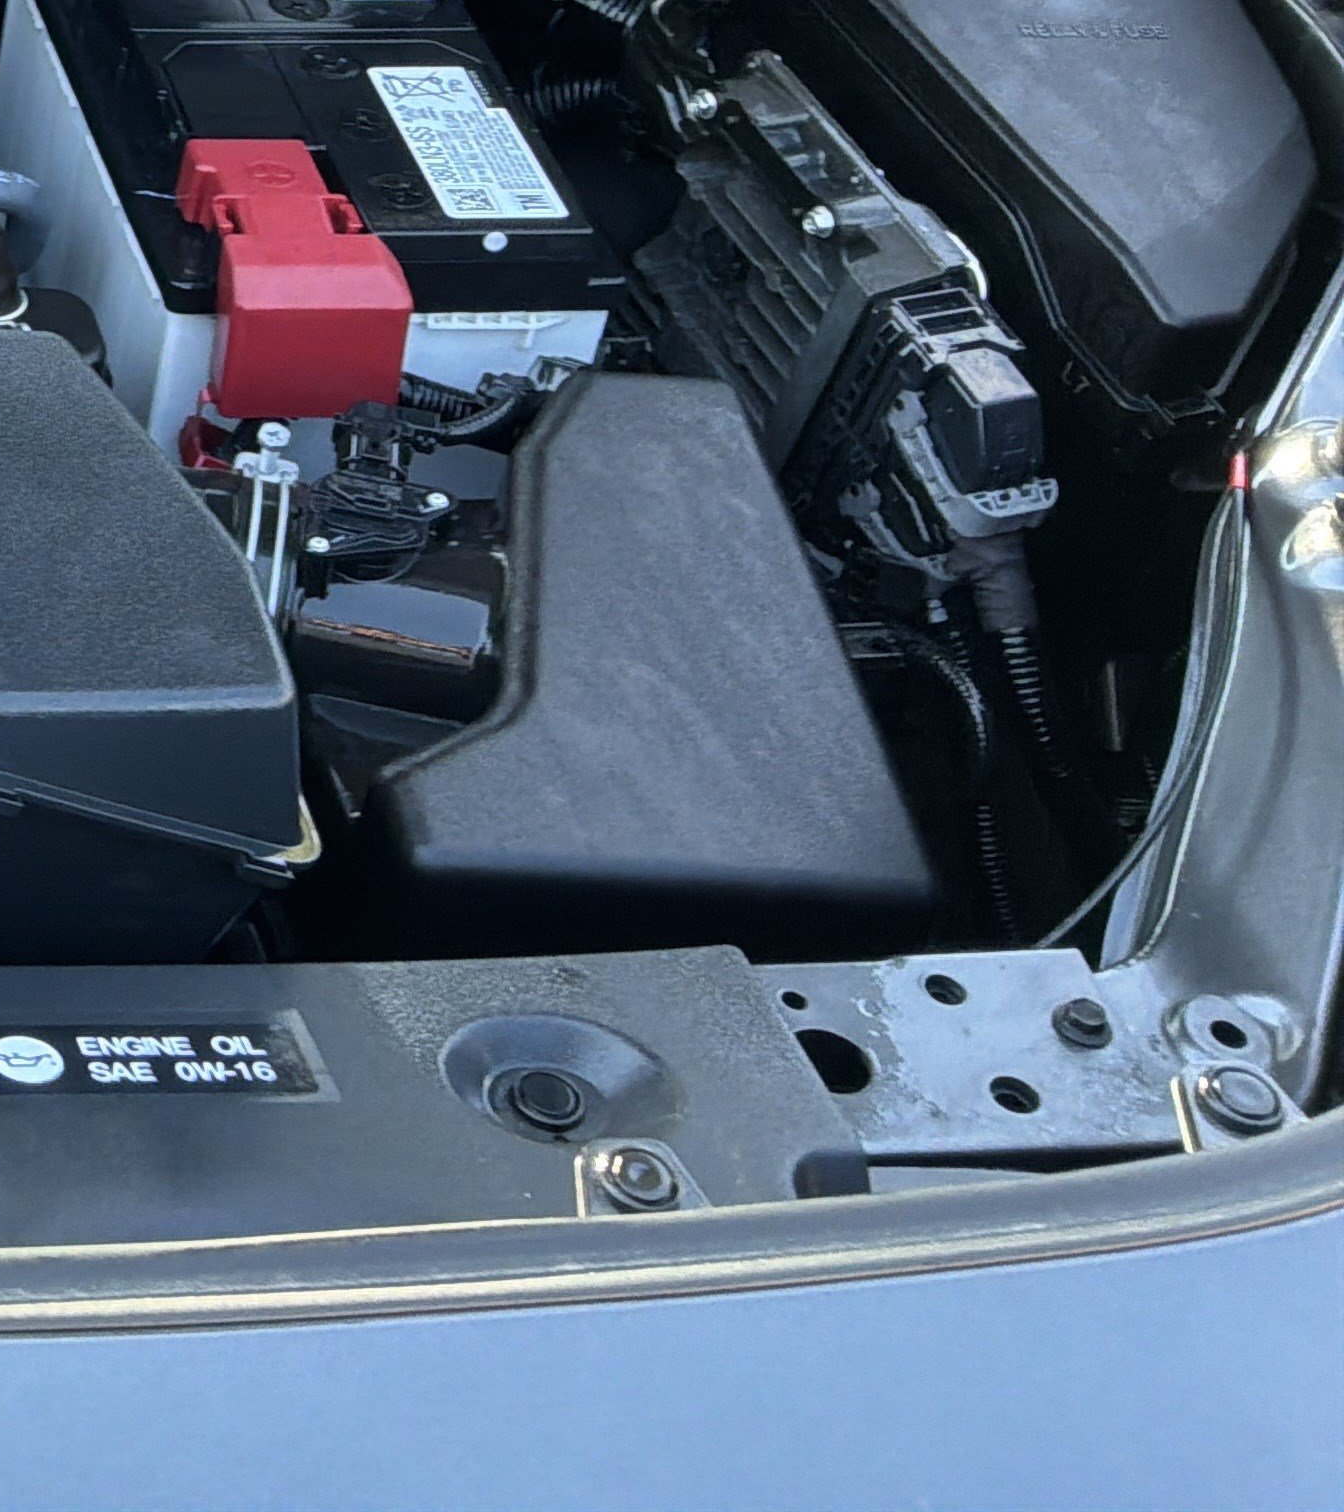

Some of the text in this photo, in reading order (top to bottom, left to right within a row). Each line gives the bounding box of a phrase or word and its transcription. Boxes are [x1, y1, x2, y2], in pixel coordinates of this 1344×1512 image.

[1111, 25, 1169, 40] FUSE
[75, 1036, 267, 1057] ENGINE OIL
[89, 1061, 278, 1082] SAE 0W-16
